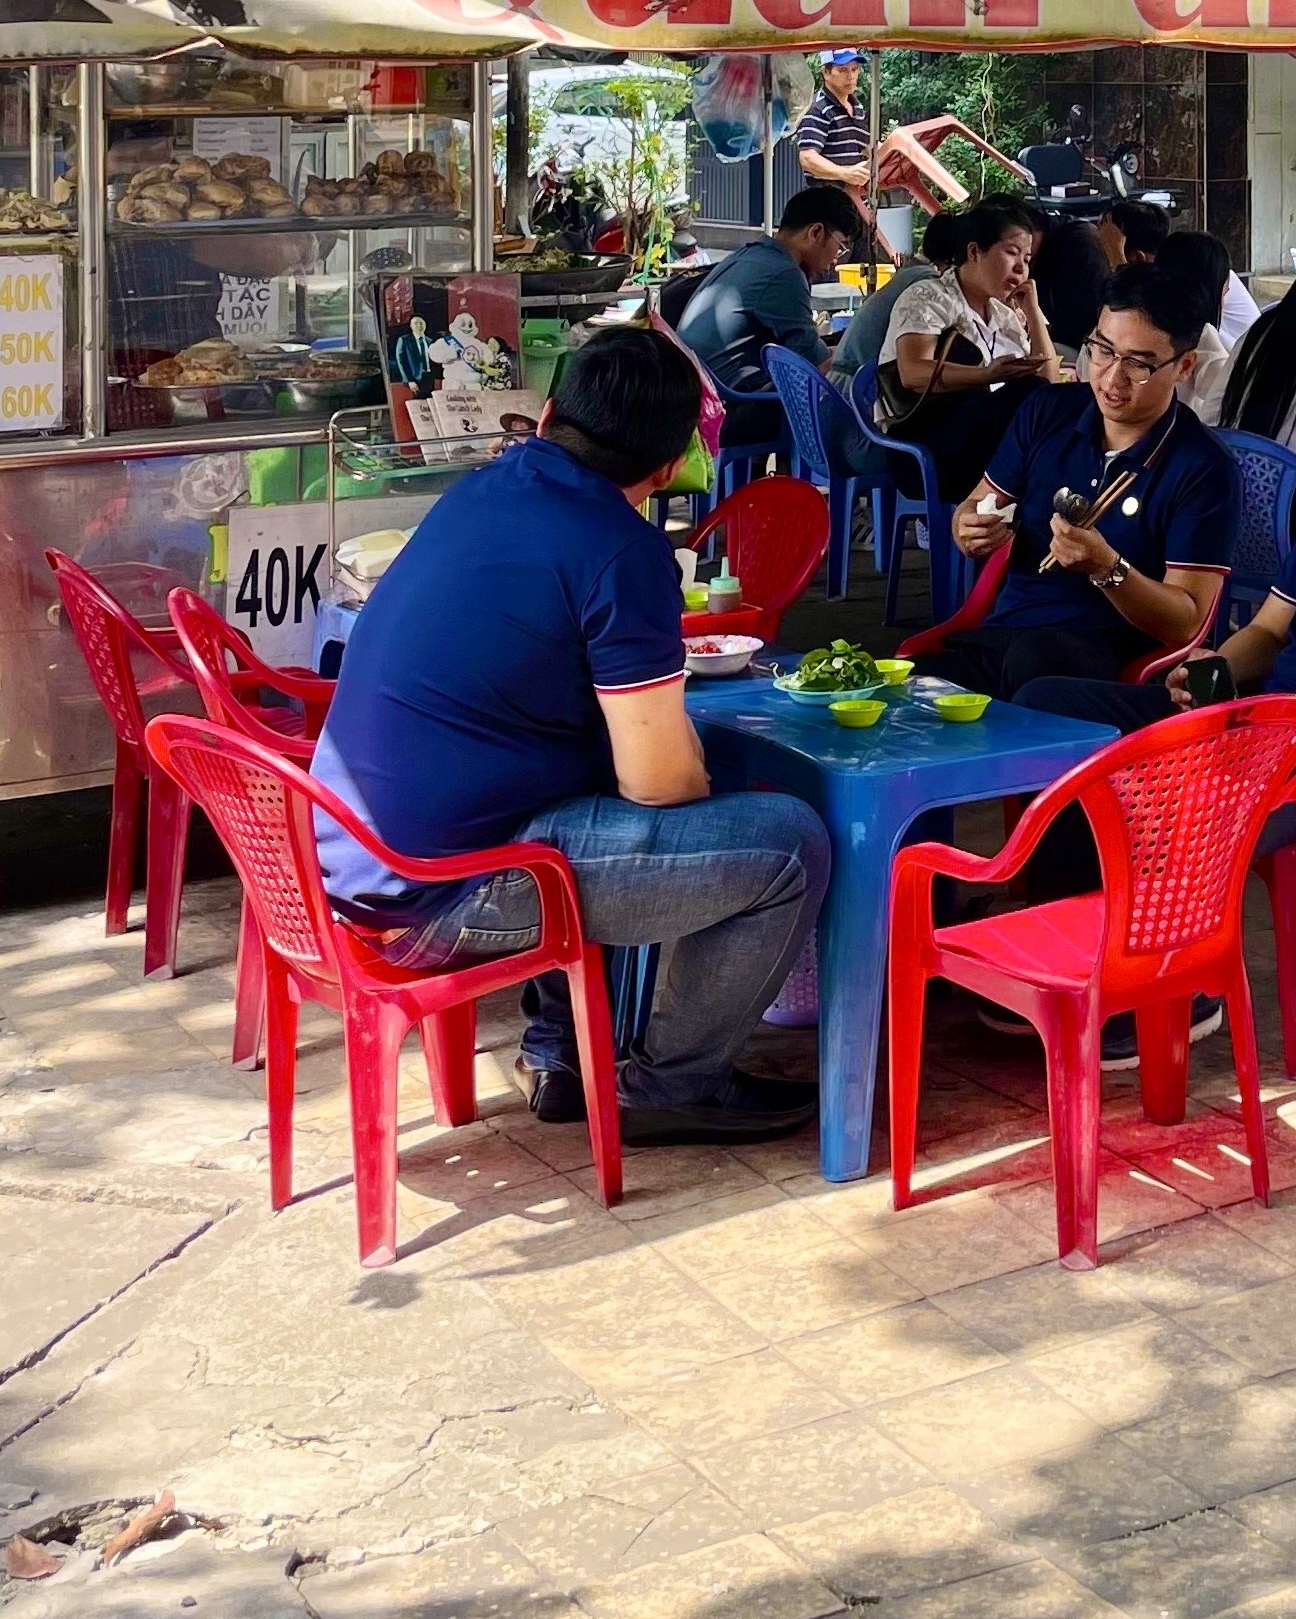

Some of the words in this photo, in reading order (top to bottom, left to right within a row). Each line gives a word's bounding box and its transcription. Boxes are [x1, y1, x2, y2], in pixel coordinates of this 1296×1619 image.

[0, 272, 52, 312] 40K
[0, 331, 55, 365] 50K
[2, 383, 54, 419] 60K
[234, 542, 328, 628] 40K
